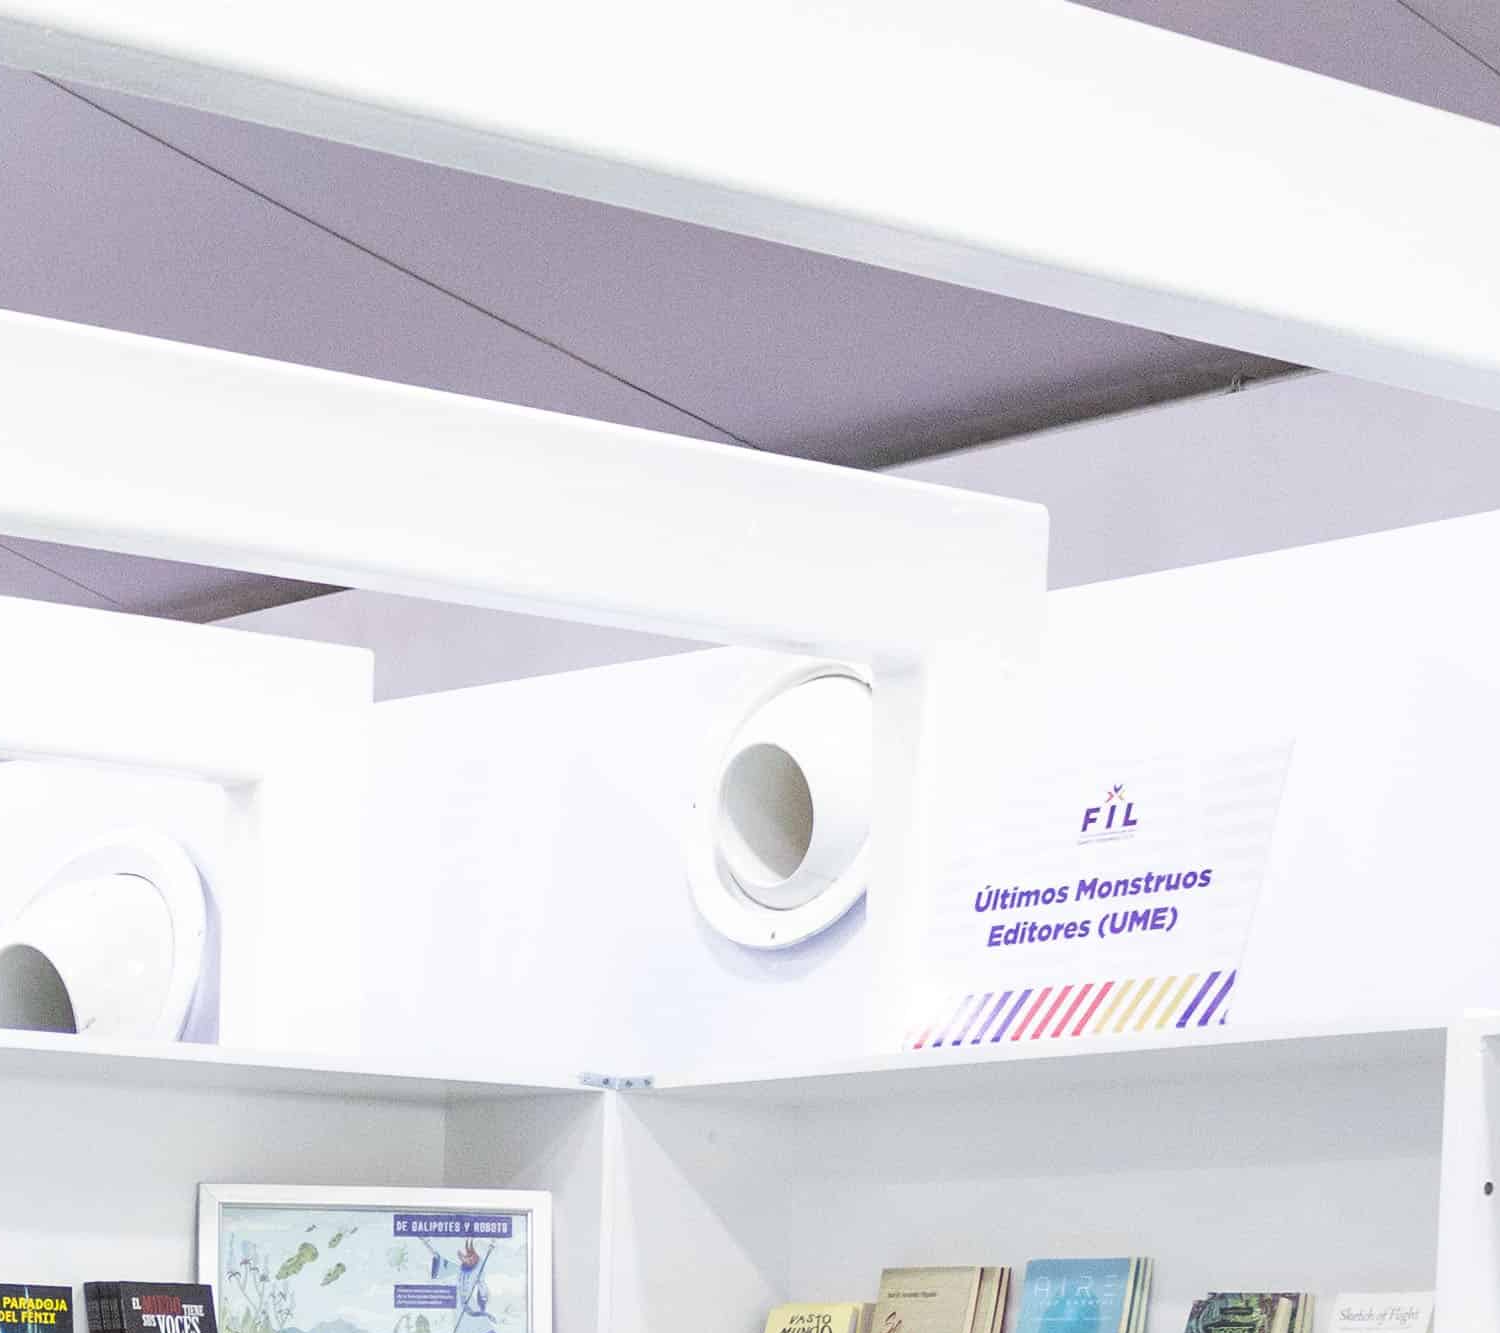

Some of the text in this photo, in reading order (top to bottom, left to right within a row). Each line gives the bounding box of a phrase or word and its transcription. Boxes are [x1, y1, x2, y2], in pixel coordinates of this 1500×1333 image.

[1081, 802, 1138, 832] FIL
[974, 867, 1213, 913] Últimos Monstruos
[987, 906, 1179, 948] Editores (UME)
[1, 1296, 68, 1312] PARADOJA
[132, 1297, 142, 1310] EL
[789, 1312, 832, 1325] VASTO
